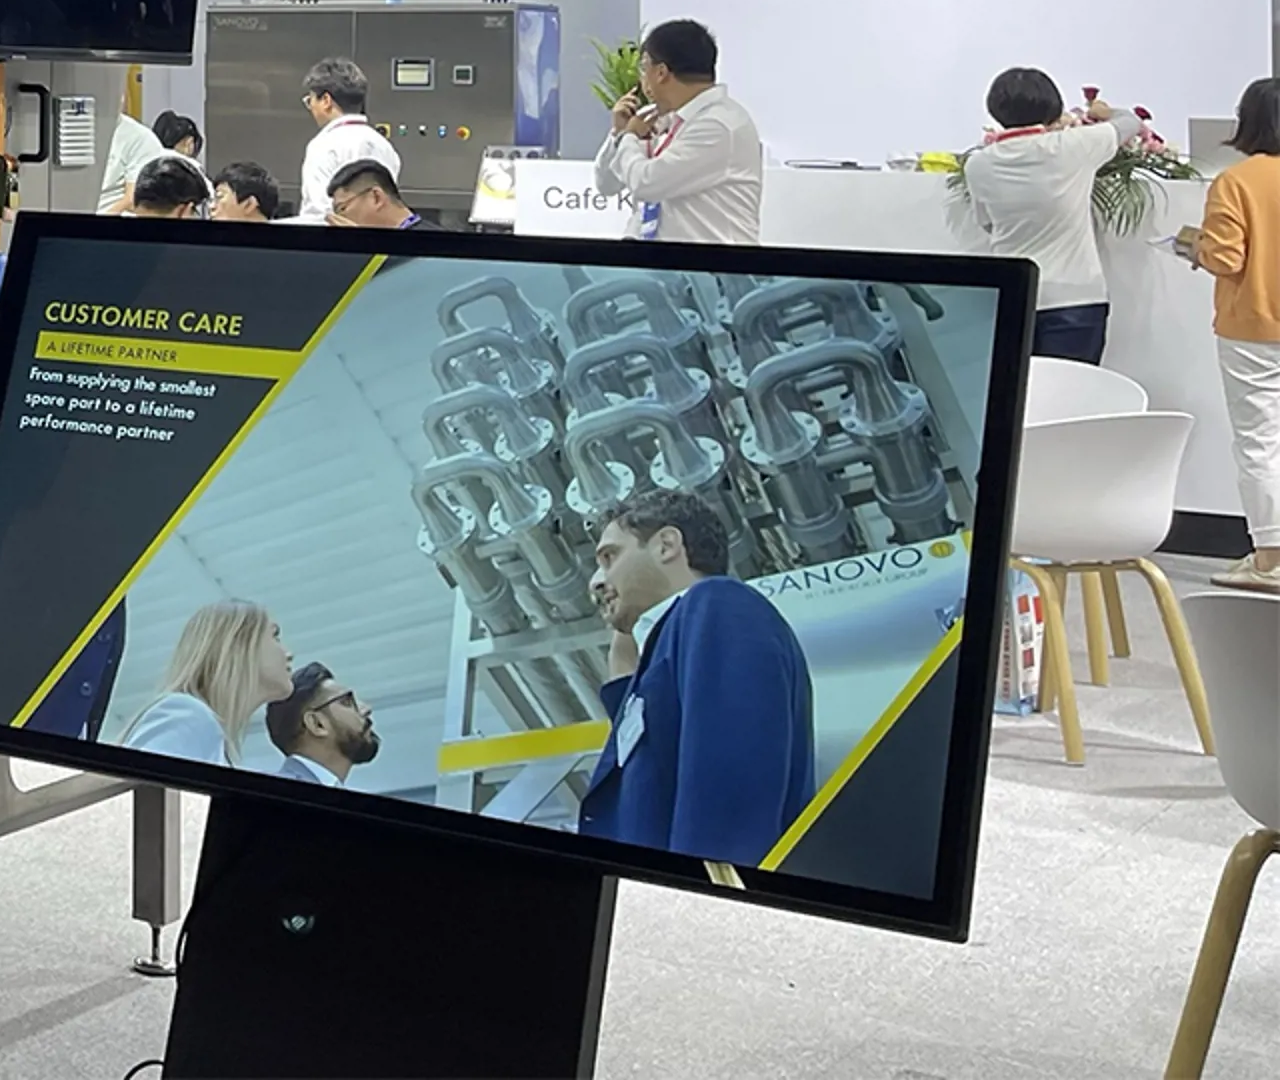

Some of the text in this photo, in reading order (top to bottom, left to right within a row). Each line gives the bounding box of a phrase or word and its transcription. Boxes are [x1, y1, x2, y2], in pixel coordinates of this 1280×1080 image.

[543, 185, 608, 210] Cafe
[45, 302, 243, 336] CUSTOMER CARE
[46, 341, 178, 363] A LIFETIME PARTNER
[30, 366, 216, 397] From supplying the smallest
[25, 393, 196, 420] spare part to a lifetime
[20, 413, 175, 441] performance partner
[757, 547, 923, 598] SANOVO
